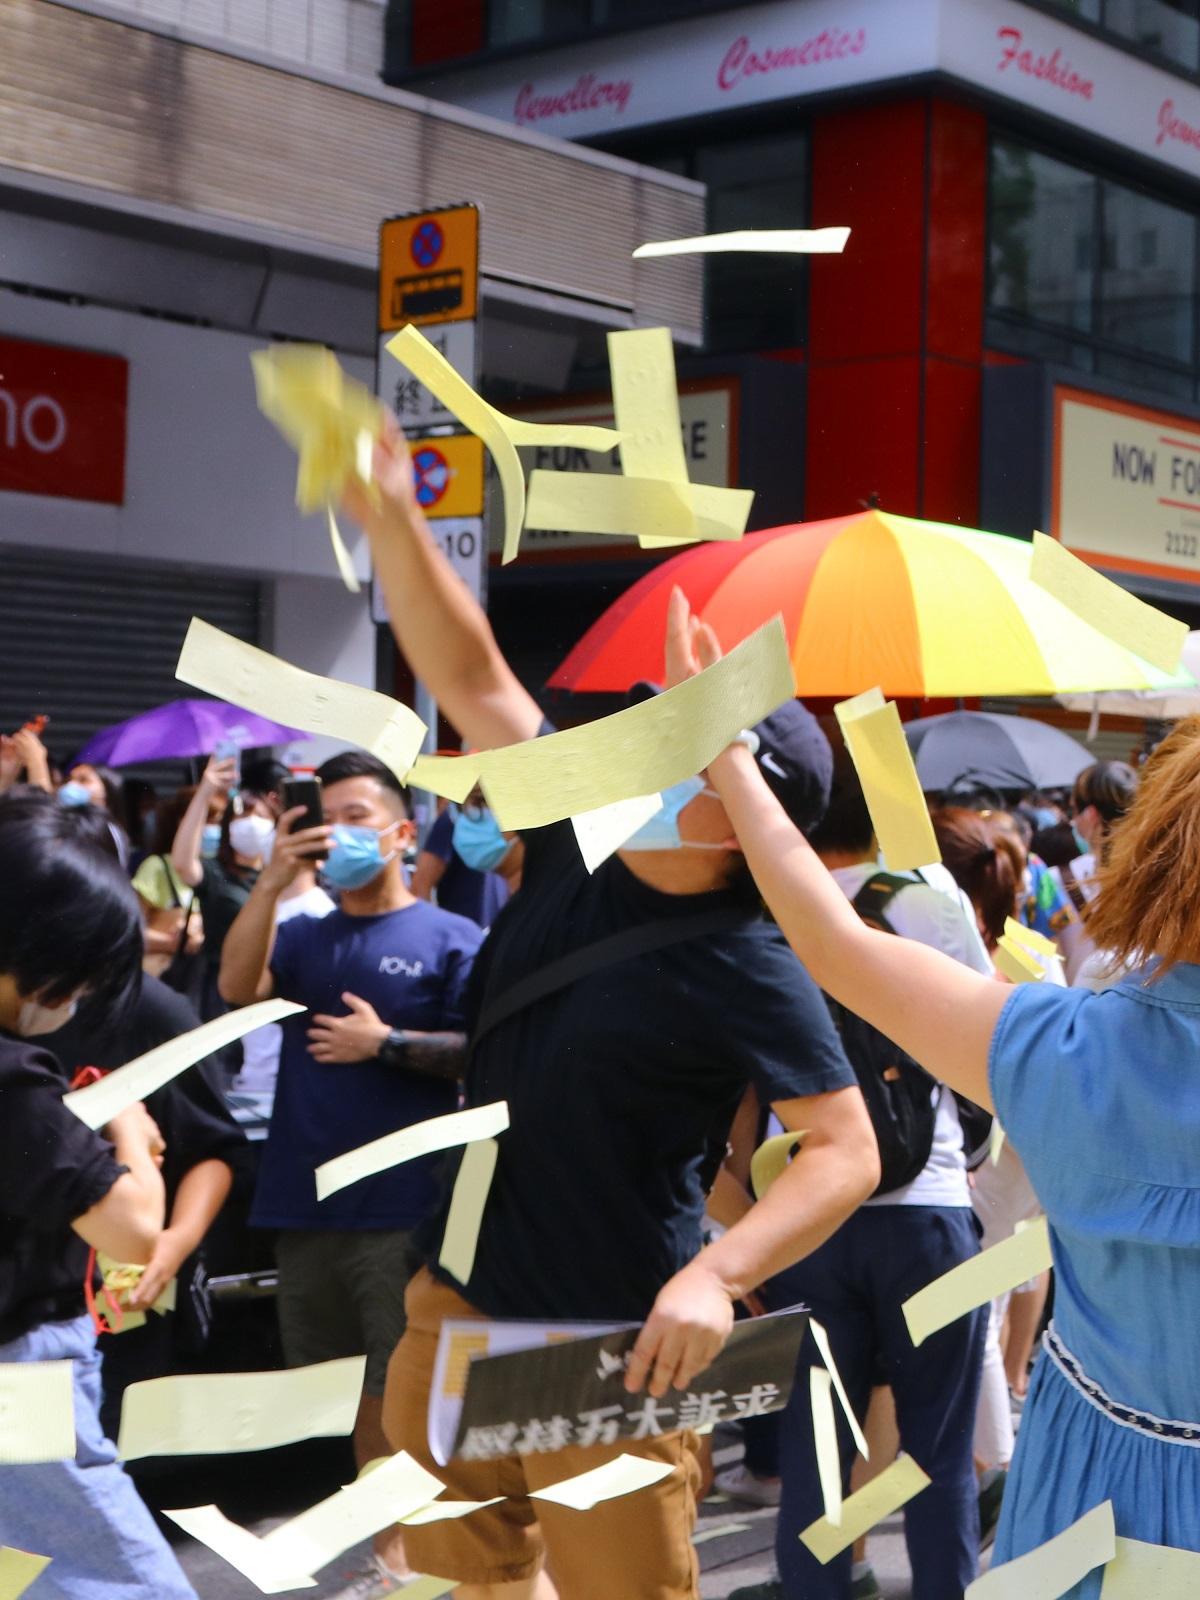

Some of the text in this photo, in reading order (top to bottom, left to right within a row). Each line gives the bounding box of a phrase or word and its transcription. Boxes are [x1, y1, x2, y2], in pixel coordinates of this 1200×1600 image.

[716, 28, 866, 91] Cosmetics
[996, 26, 1095, 101] Fashion
[514, 72, 633, 125] Jewellery
[1112, 442, 1158, 487] NOW
